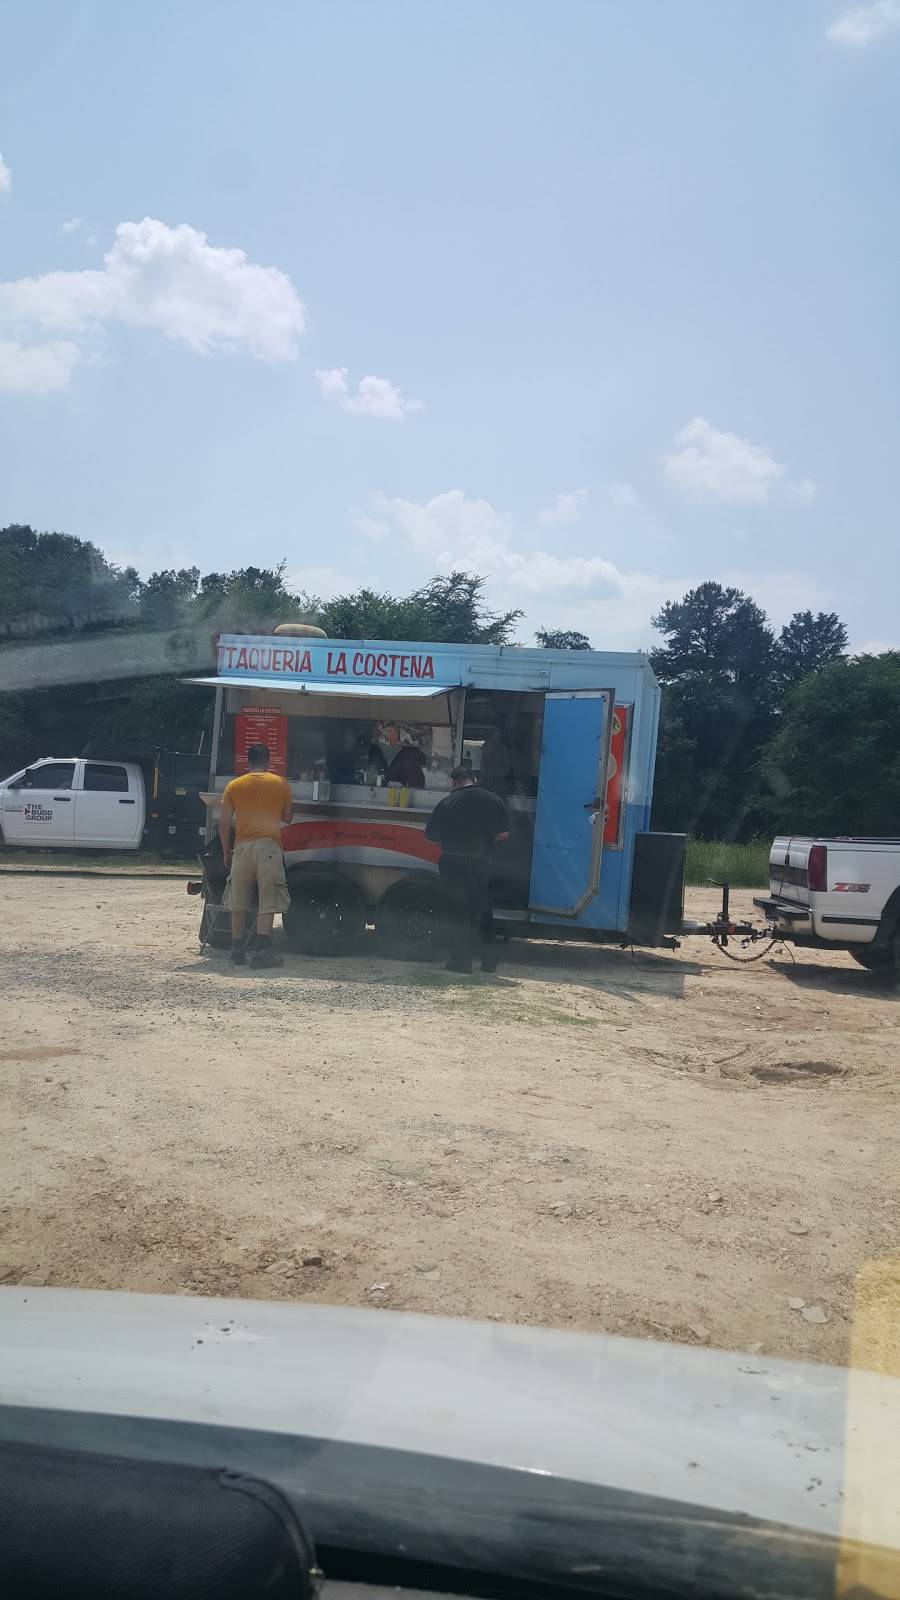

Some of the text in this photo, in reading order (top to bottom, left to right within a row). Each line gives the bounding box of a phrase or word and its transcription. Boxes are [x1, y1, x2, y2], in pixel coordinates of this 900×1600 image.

[225, 646, 435, 679] TAQUERIA LA COSTENA
